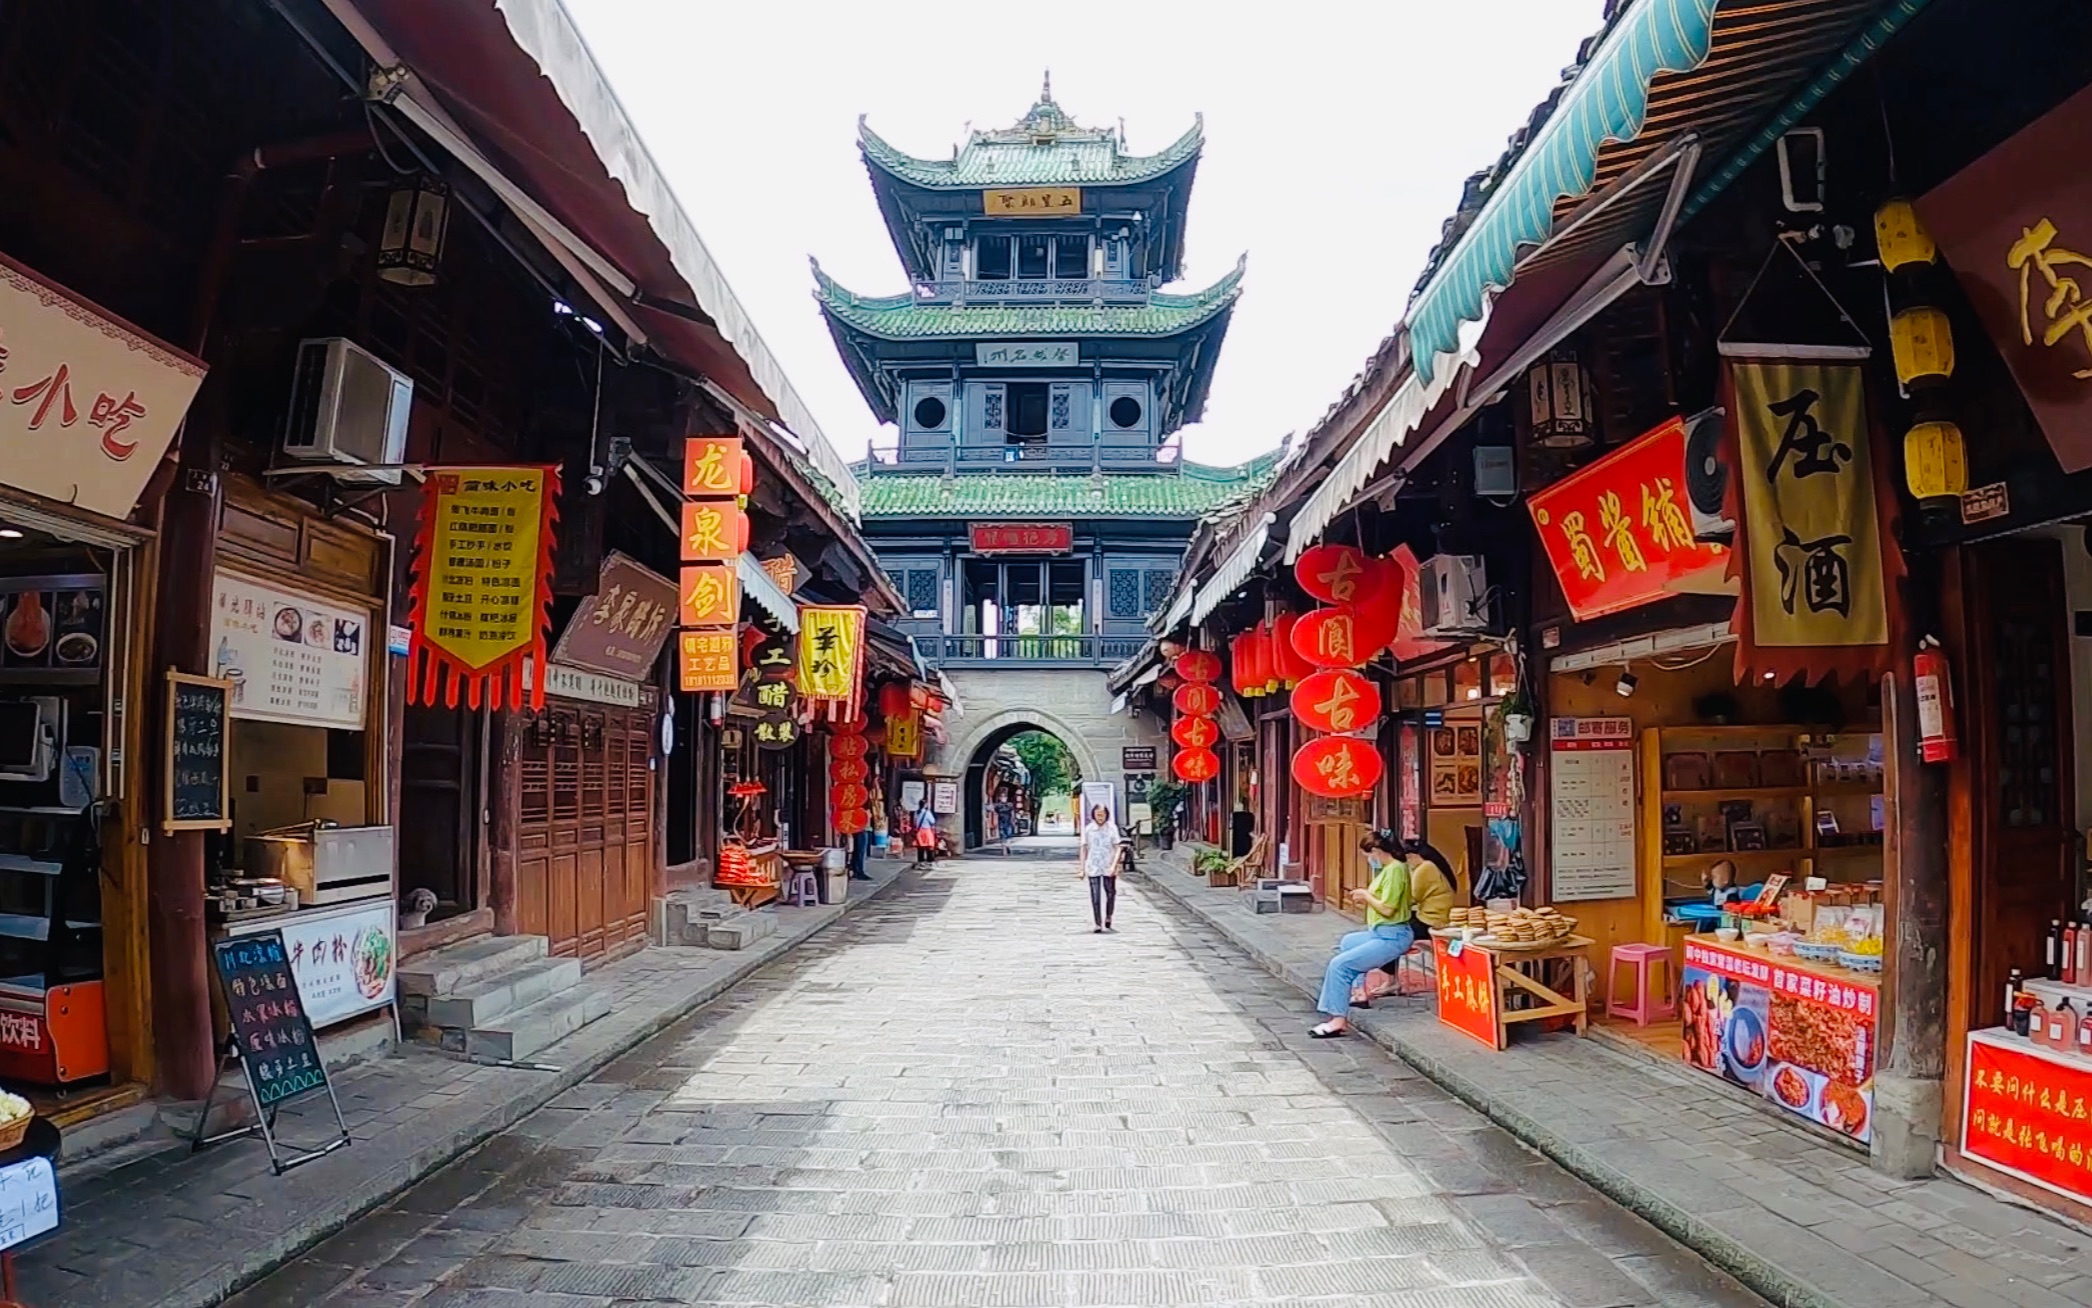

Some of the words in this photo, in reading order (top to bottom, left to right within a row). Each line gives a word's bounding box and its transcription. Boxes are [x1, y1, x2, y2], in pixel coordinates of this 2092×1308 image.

[0, 344, 146, 461] 小吃
[686, 444, 733, 620] 龙泉剑
[689, 655, 730, 671] 工艺品
[1578, 721, 1629, 734] 邮寄服务
[289, 933, 347, 972] 牛肉粉
[1974, 1069, 2092, 1120] 不要问什么是压
[1973, 1108, 2092, 1173] 问就是张飞喝的
